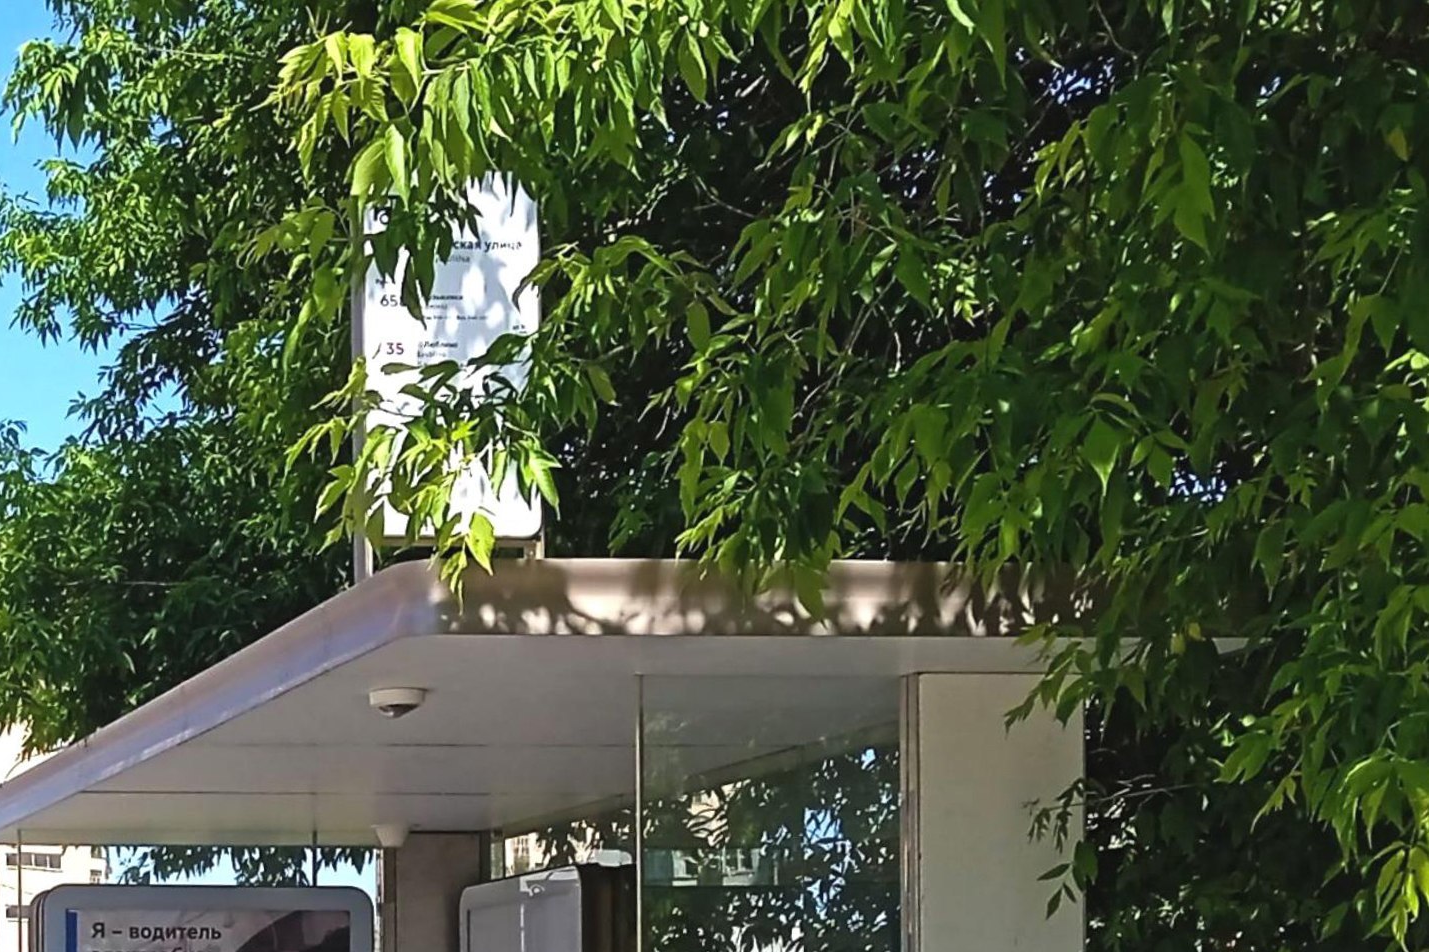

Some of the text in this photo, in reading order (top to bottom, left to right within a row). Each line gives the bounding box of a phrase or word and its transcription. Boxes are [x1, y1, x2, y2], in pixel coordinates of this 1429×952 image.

[386, 342, 404, 355] 35
[91, 922, 105, 938] Я
[129, 926, 222, 941] водитель
